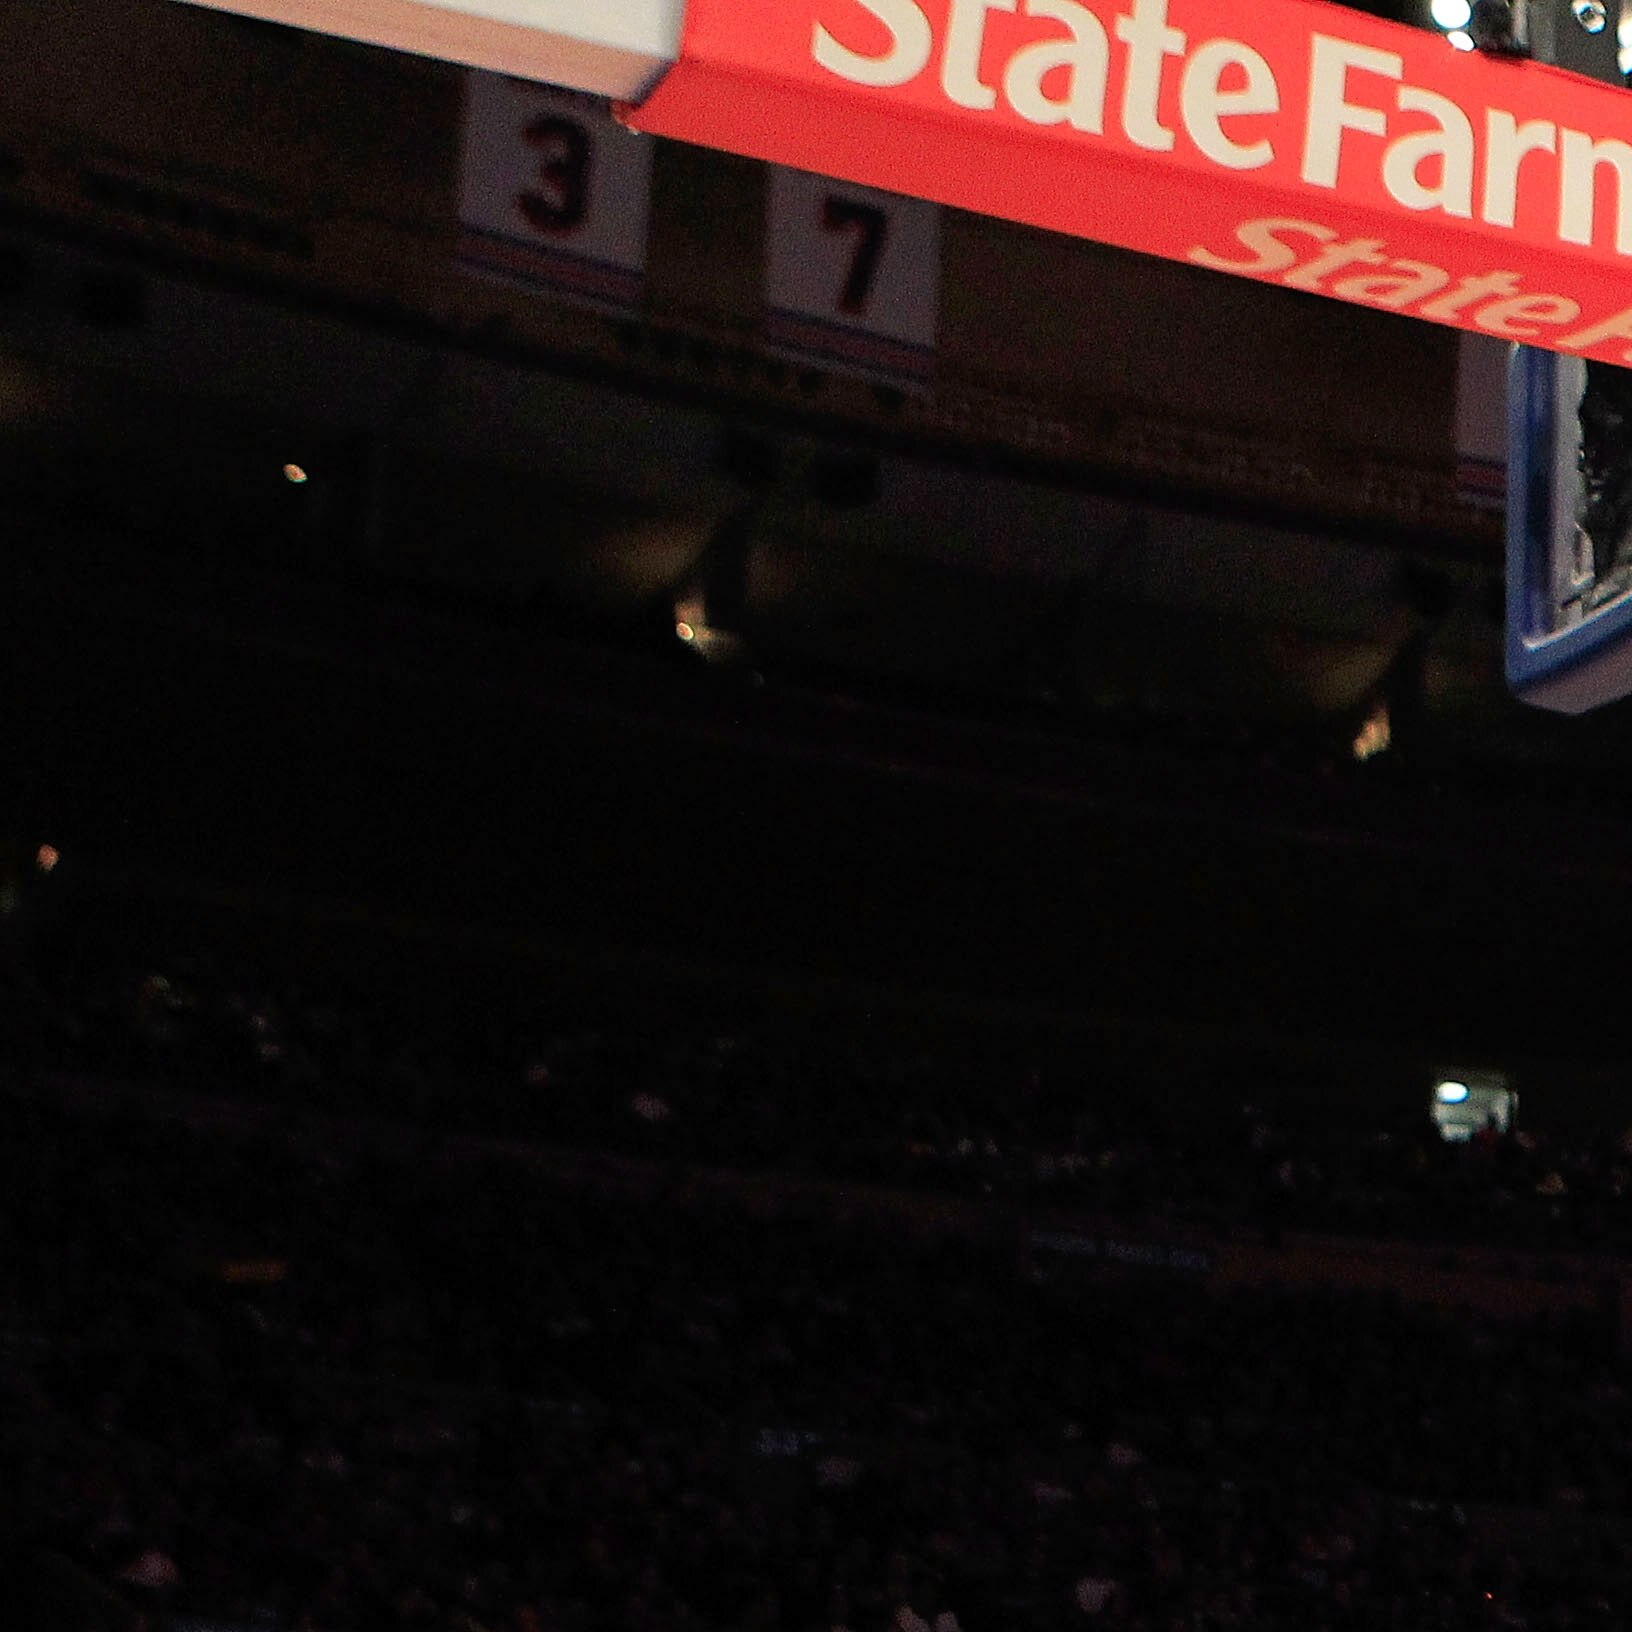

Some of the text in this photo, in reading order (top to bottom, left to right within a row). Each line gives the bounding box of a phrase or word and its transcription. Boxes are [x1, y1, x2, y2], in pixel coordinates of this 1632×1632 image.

[813, 0, 1278, 169] State
[519, 112, 589, 234] 3
[823, 198, 887, 314] 7
[1189, 217, 1581, 338] State
